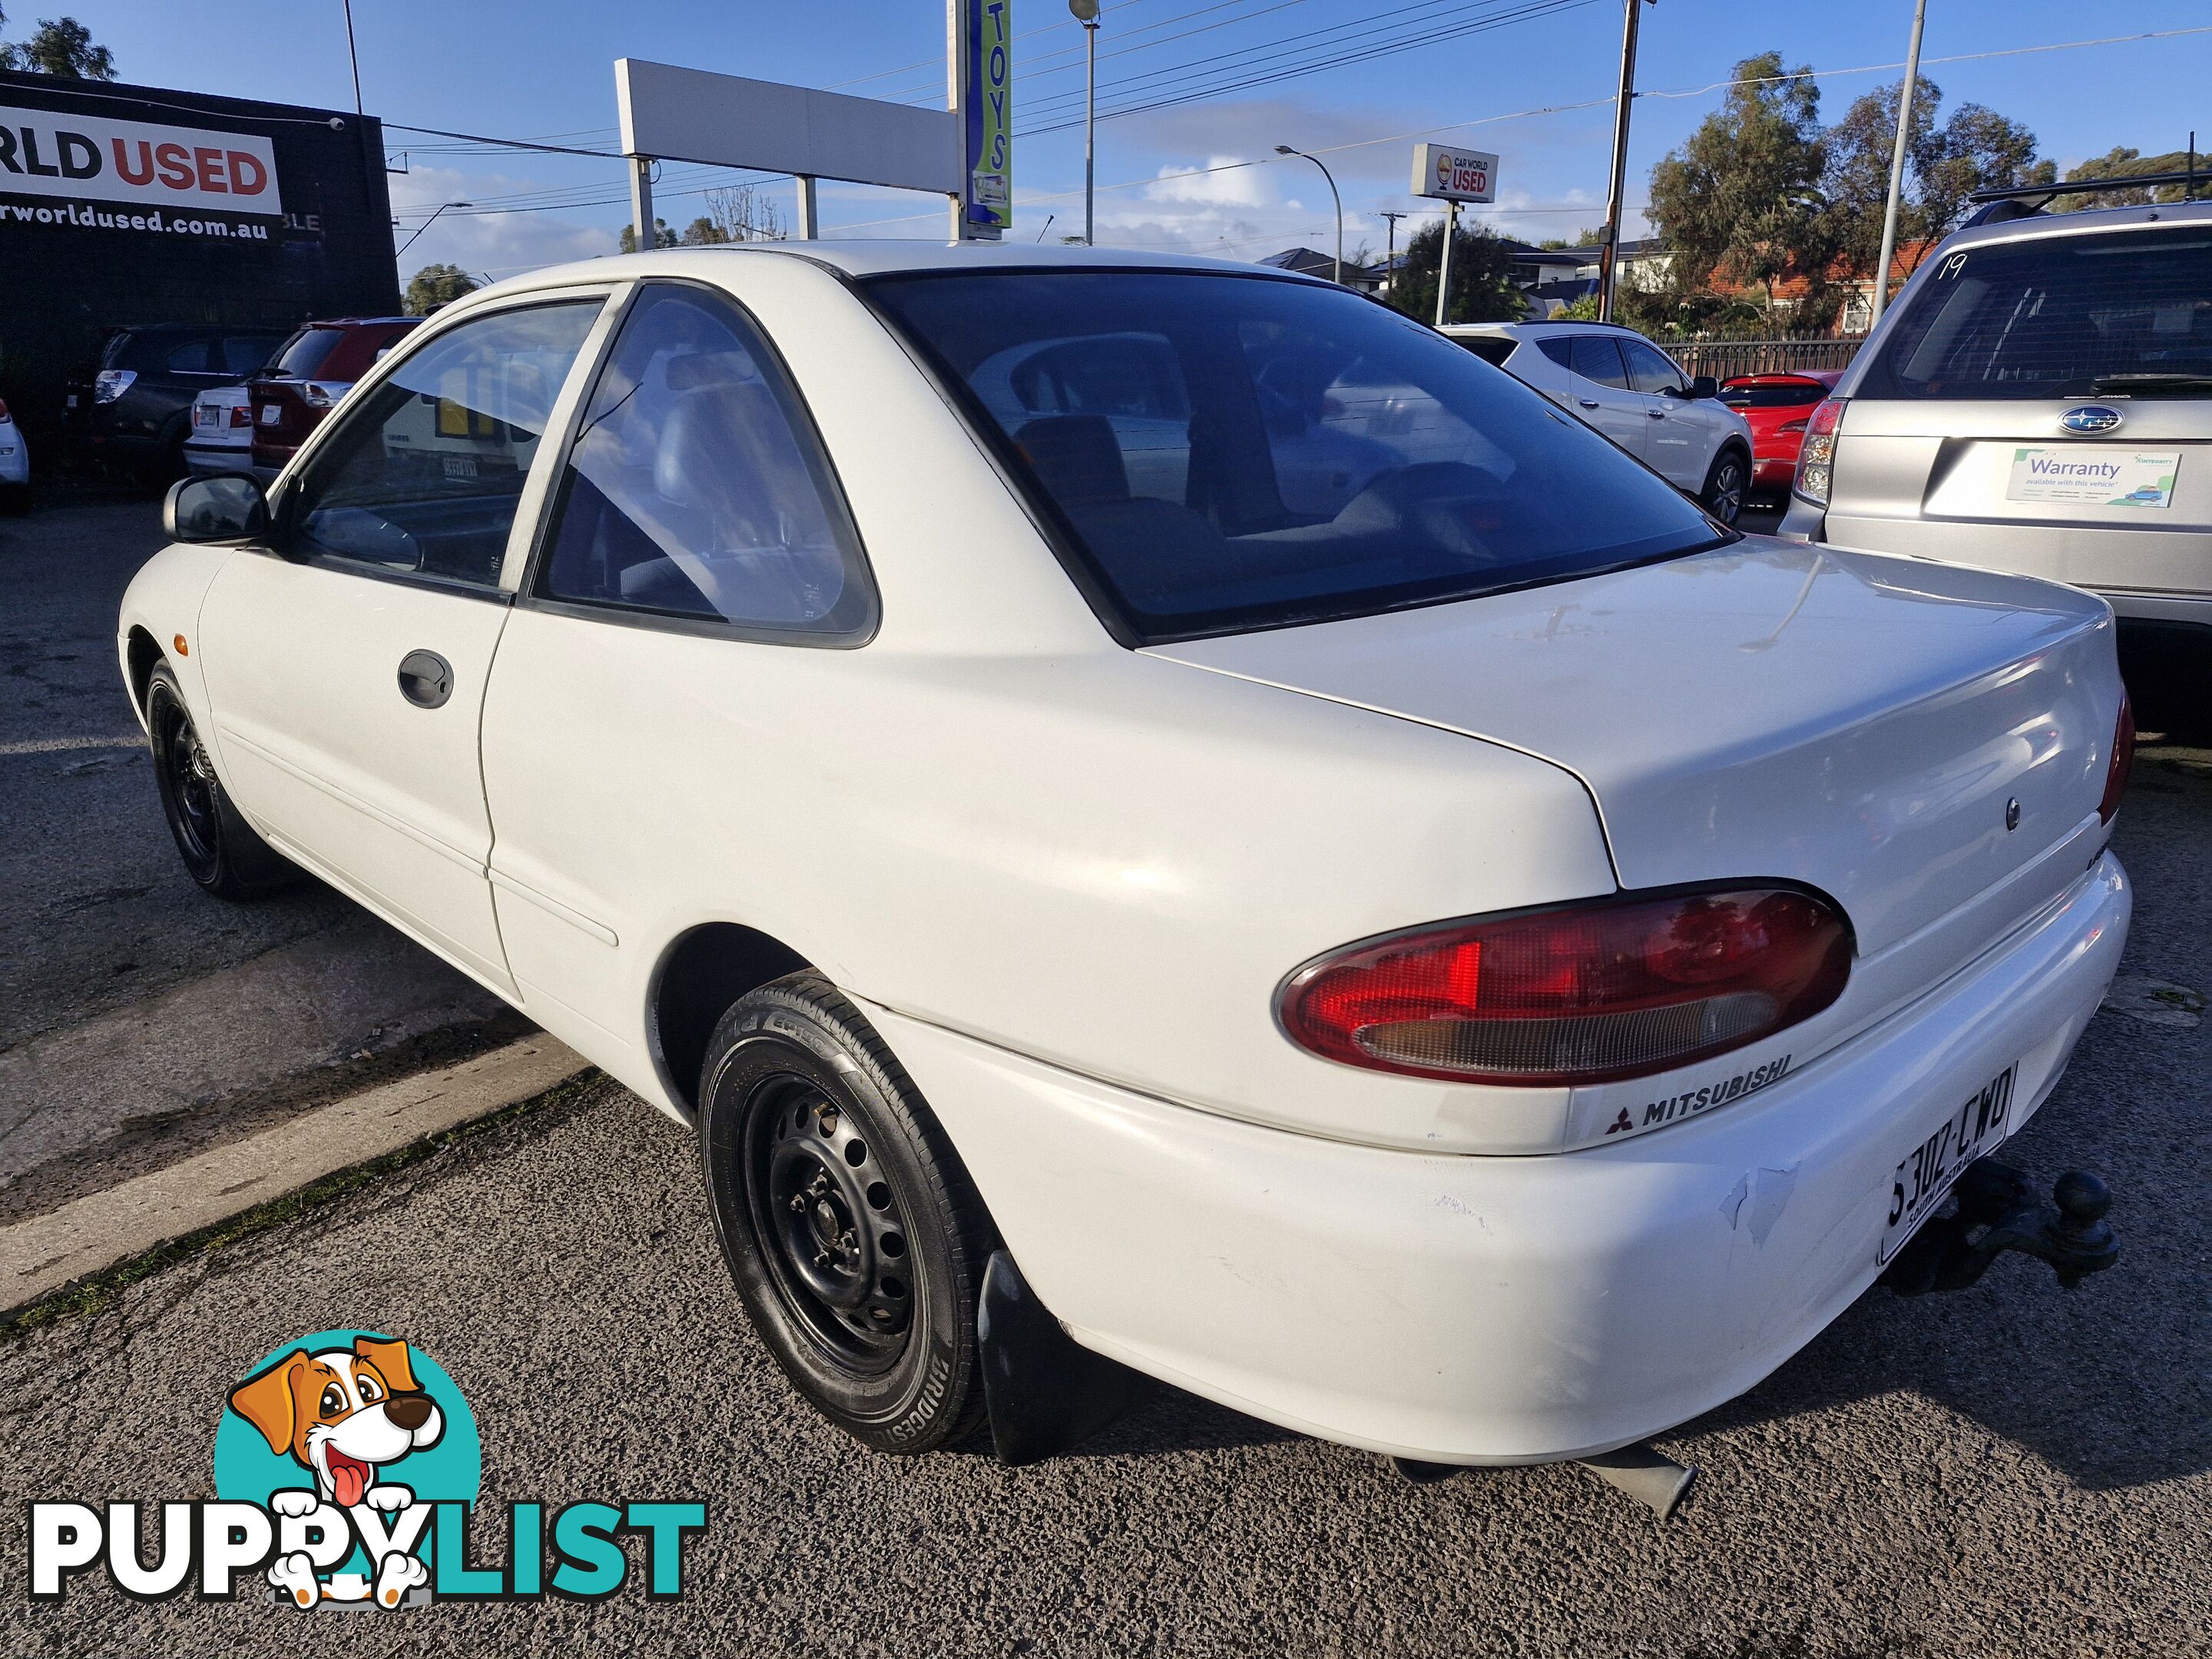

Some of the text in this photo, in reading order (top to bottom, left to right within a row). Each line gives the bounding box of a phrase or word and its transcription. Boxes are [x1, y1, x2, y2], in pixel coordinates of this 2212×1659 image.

[988, 2, 1007, 171] TOYS
[111, 137, 267, 196] USED
[1453, 169, 1486, 193] USED
[1454, 157, 1488, 171] CAR WORLD
[1938, 253, 1968, 280] 19
[2031, 459, 2121, 480] Warranty
[1642, 1055, 1791, 1127] MITSUBISHI
[1908, 1144, 1980, 1228] SOUTH AUSTRALIA
